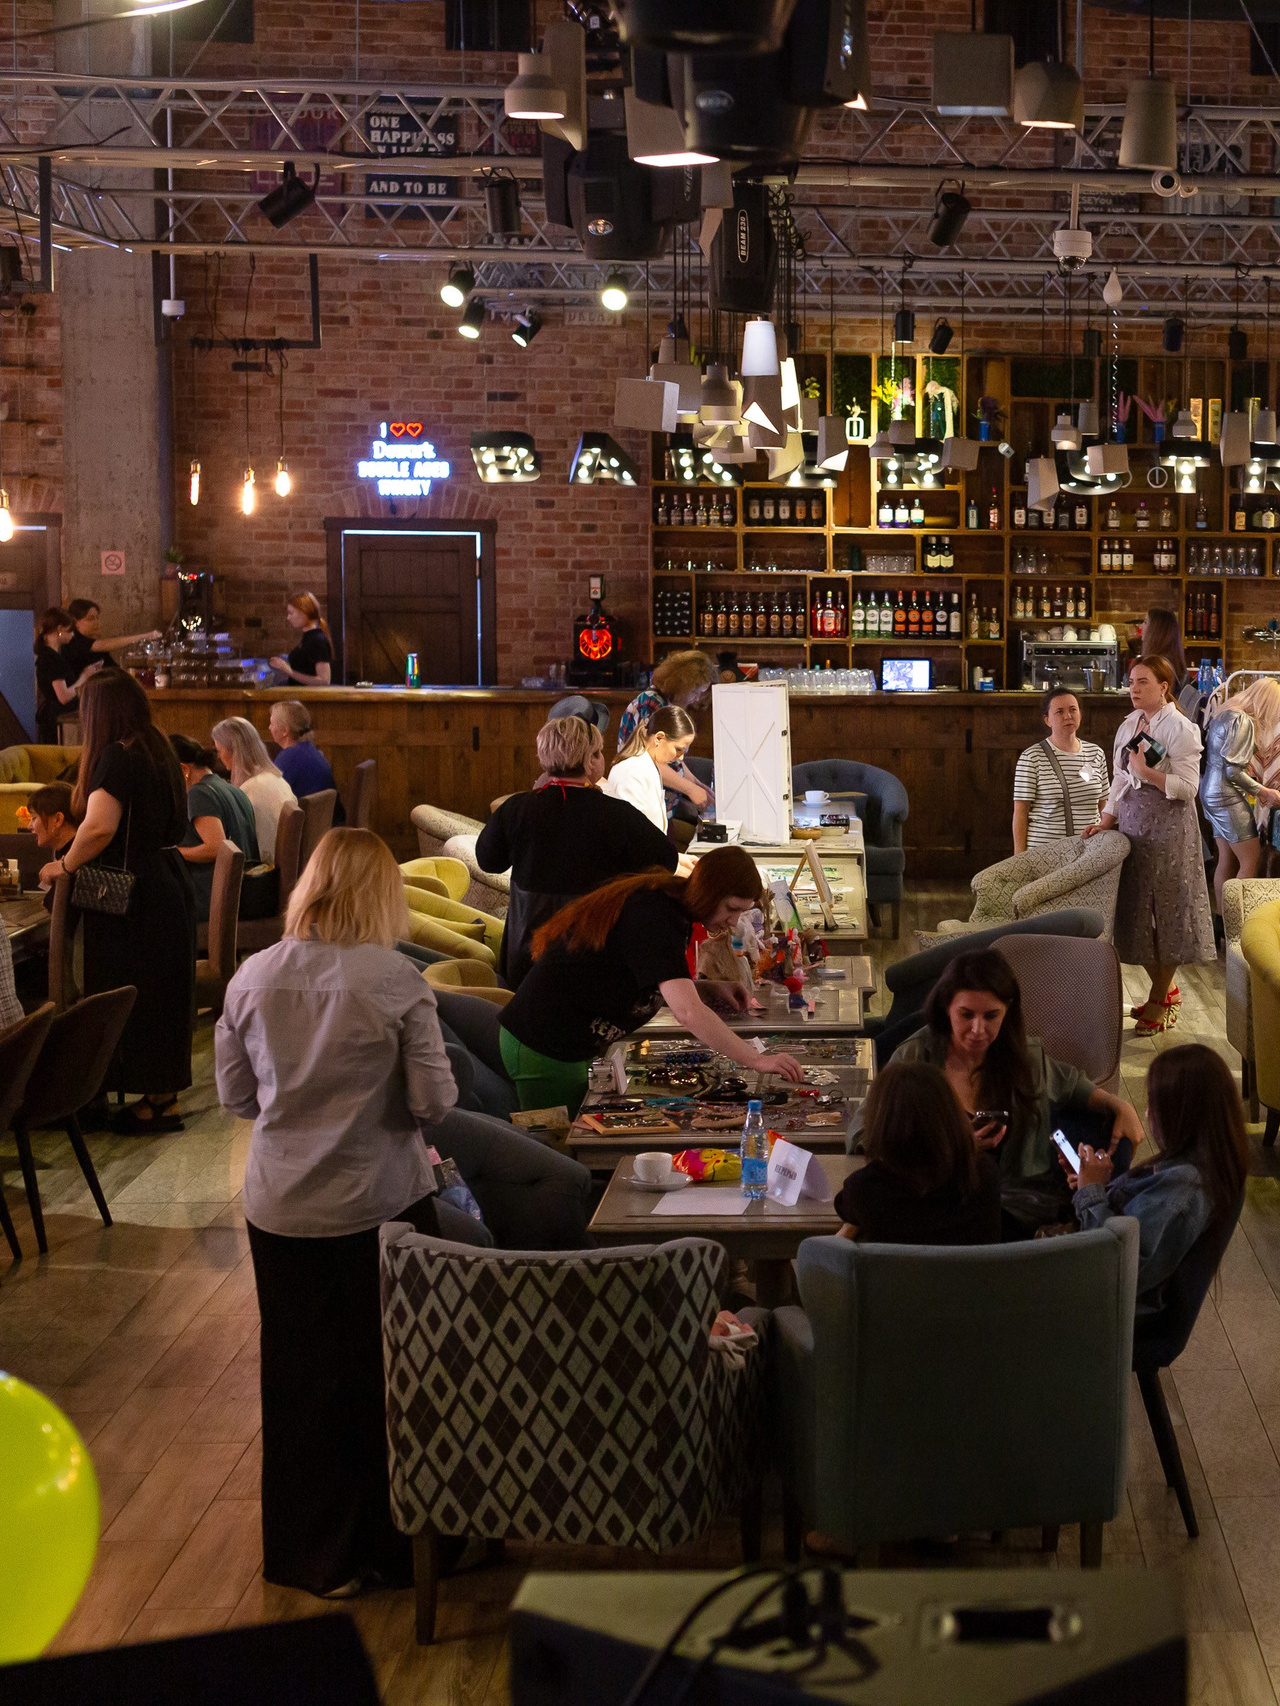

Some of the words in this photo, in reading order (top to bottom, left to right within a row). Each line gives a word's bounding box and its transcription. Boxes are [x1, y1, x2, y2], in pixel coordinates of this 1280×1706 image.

[369, 116, 400, 128] ONE
[370, 131, 456, 145] HAPPINESS
[369, 181, 399, 194] AND
[404, 182, 423, 194] TO
[427, 183, 447, 195] BE
[358, 461, 410, 478] DOUBLE
[413, 461, 451, 478] AGED
